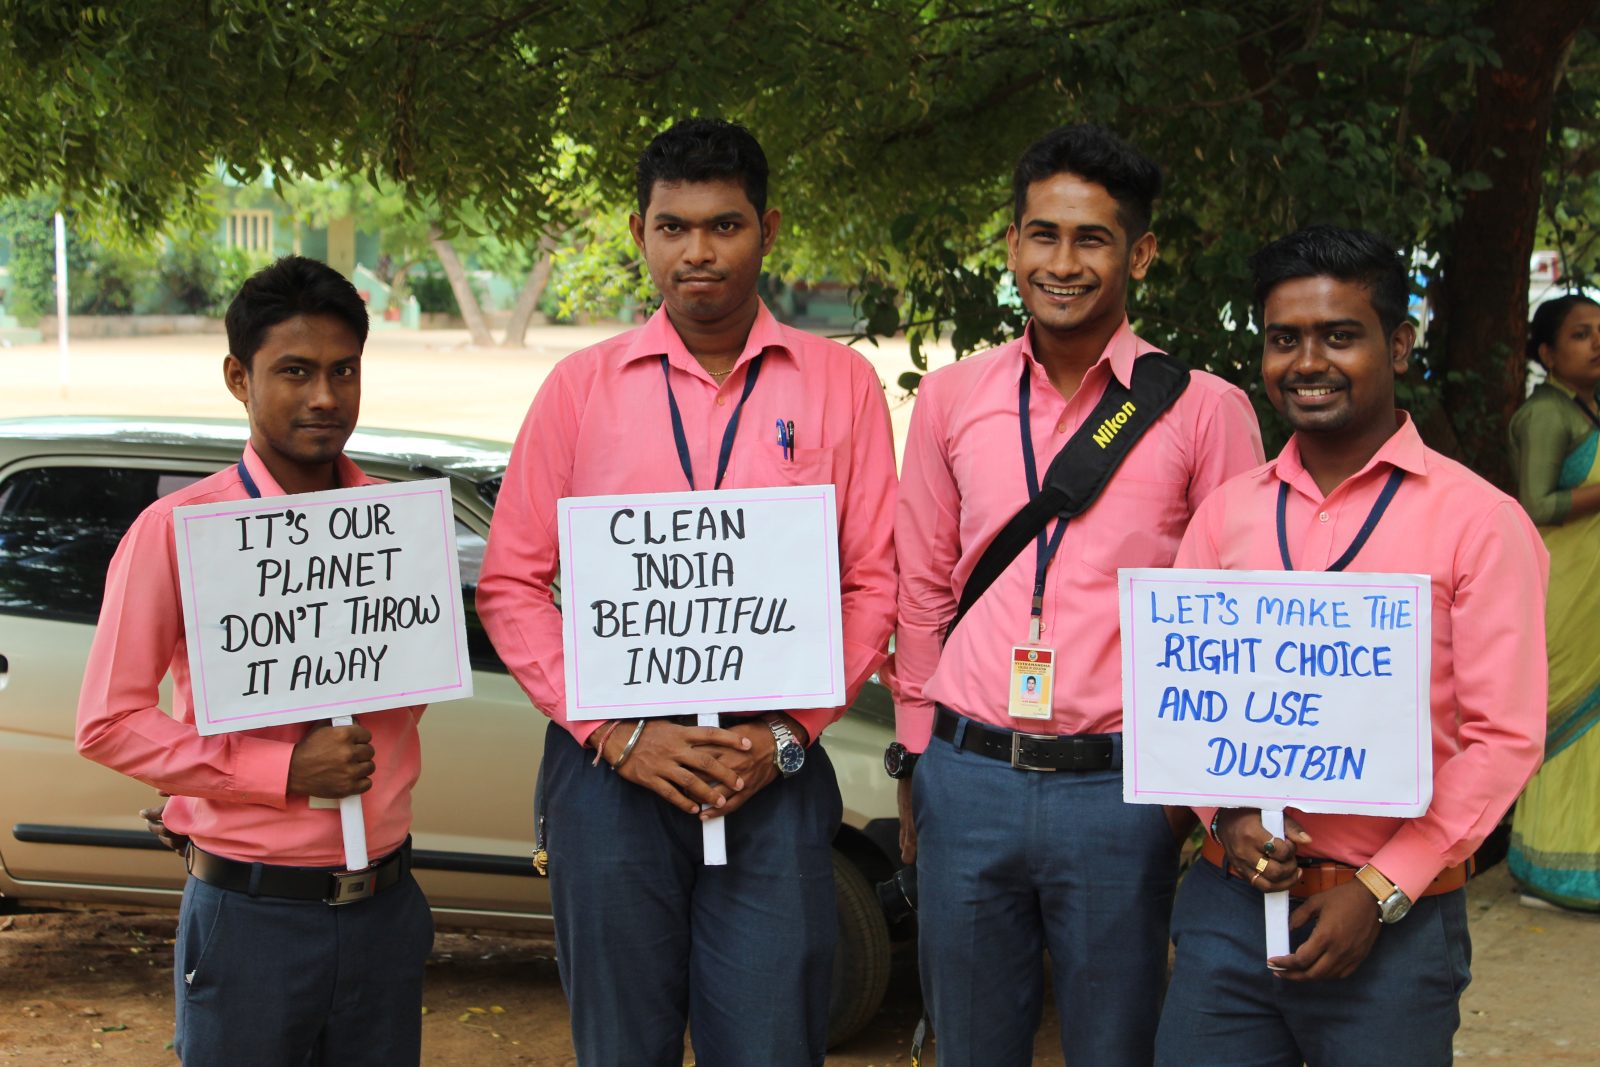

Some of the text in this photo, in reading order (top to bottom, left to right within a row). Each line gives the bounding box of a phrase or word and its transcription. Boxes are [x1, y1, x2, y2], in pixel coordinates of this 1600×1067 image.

[1092, 401, 1136, 449] Nikon
[234, 503, 396, 552] IT'S OUR
[609, 506, 746, 545] CLEAN
[256, 547, 403, 598] PLANET
[631, 551, 735, 592] INDIA
[219, 594, 441, 653] DON'T THROW
[589, 596, 797, 638] BEAUTIFUL
[1150, 591, 1413, 630] LET'S MAKE THE
[241, 644, 389, 697] IT AWAY
[623, 644, 745, 686] INDIA
[1155, 632, 1394, 678] RIGHT CHOICE
[1157, 686, 1323, 727] AND USE
[1205, 736, 1367, 781] DUSTBIN
